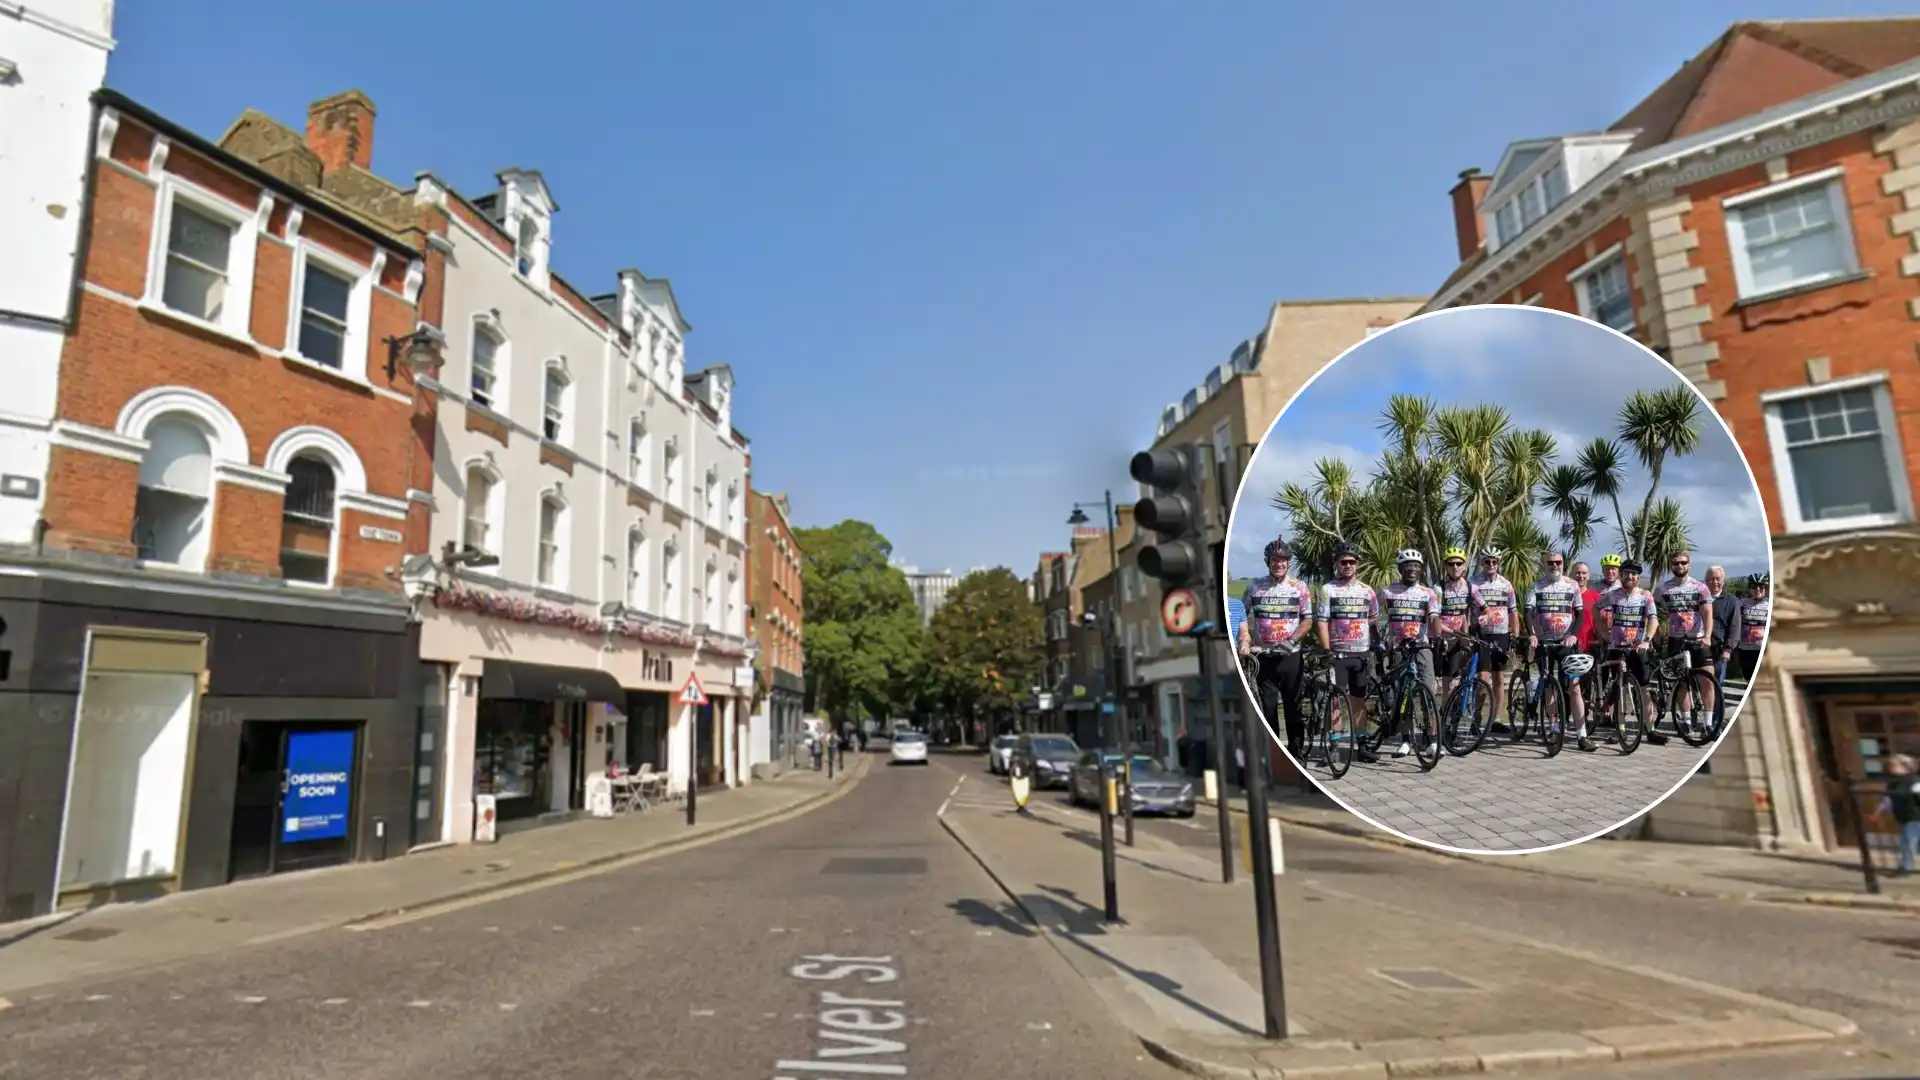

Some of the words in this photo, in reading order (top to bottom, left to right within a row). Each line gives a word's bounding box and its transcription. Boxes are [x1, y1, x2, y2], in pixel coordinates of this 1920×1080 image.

[290, 772, 347, 785] OPENING
[299, 784, 336, 798] SOON
[791, 954, 897, 983] St
